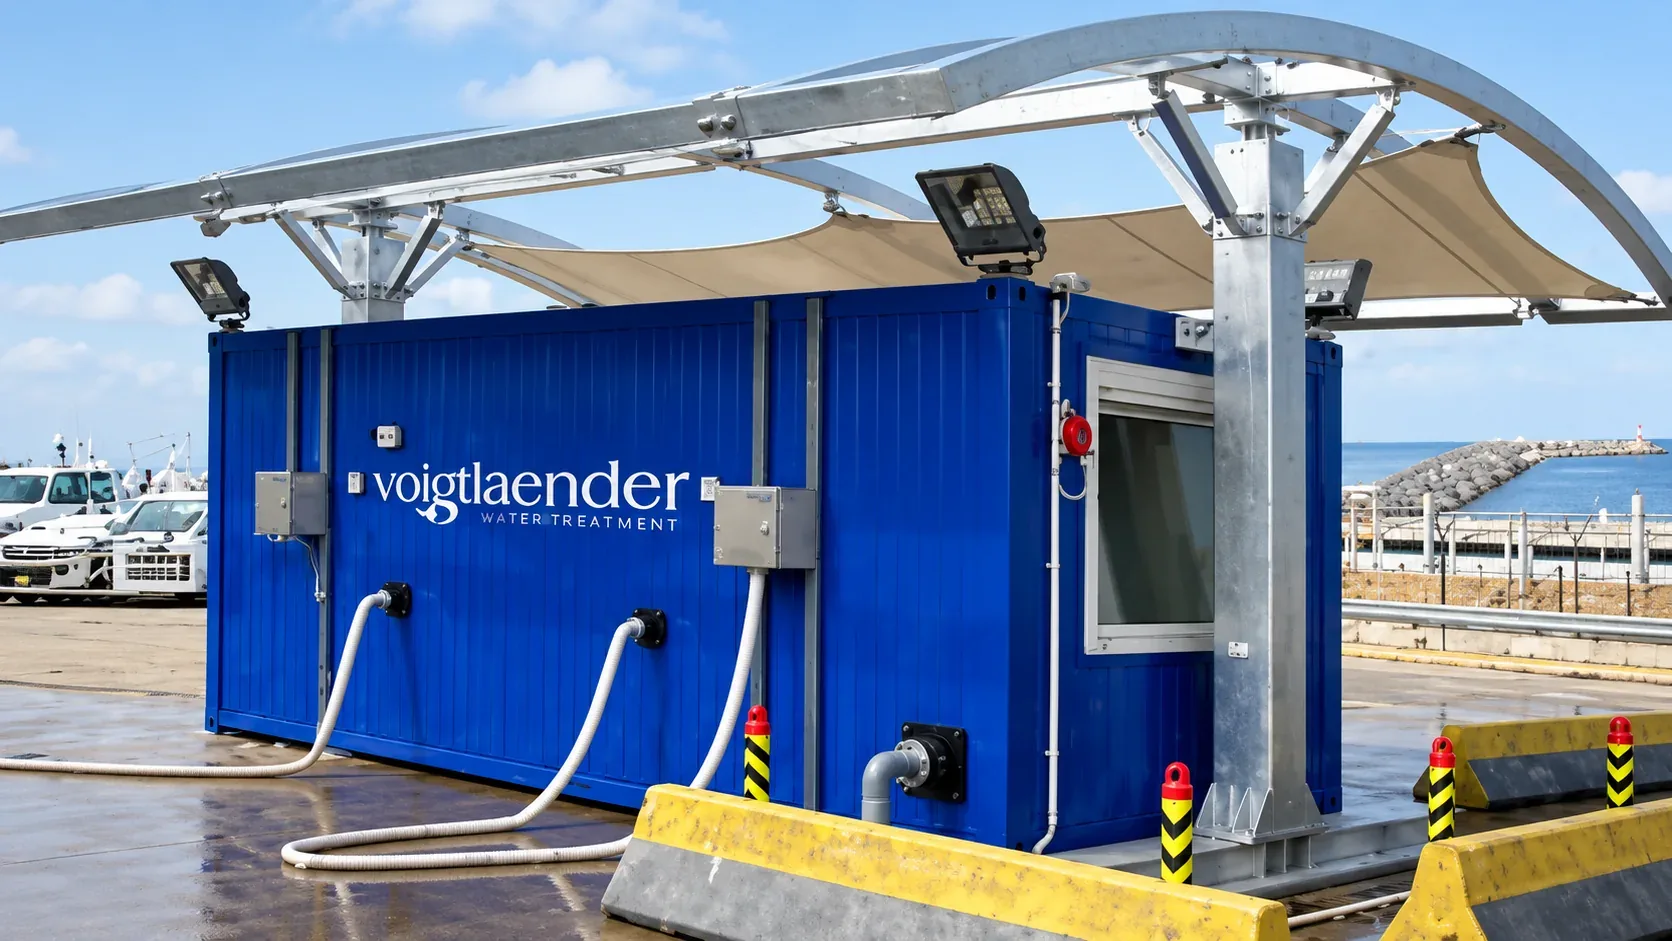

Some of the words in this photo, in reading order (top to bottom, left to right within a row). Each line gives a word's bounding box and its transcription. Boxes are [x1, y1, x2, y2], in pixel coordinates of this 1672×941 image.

[373, 460, 690, 525] voigtlaender
[481, 512, 541, 525] WATER
[551, 514, 678, 531] TREATMENT
